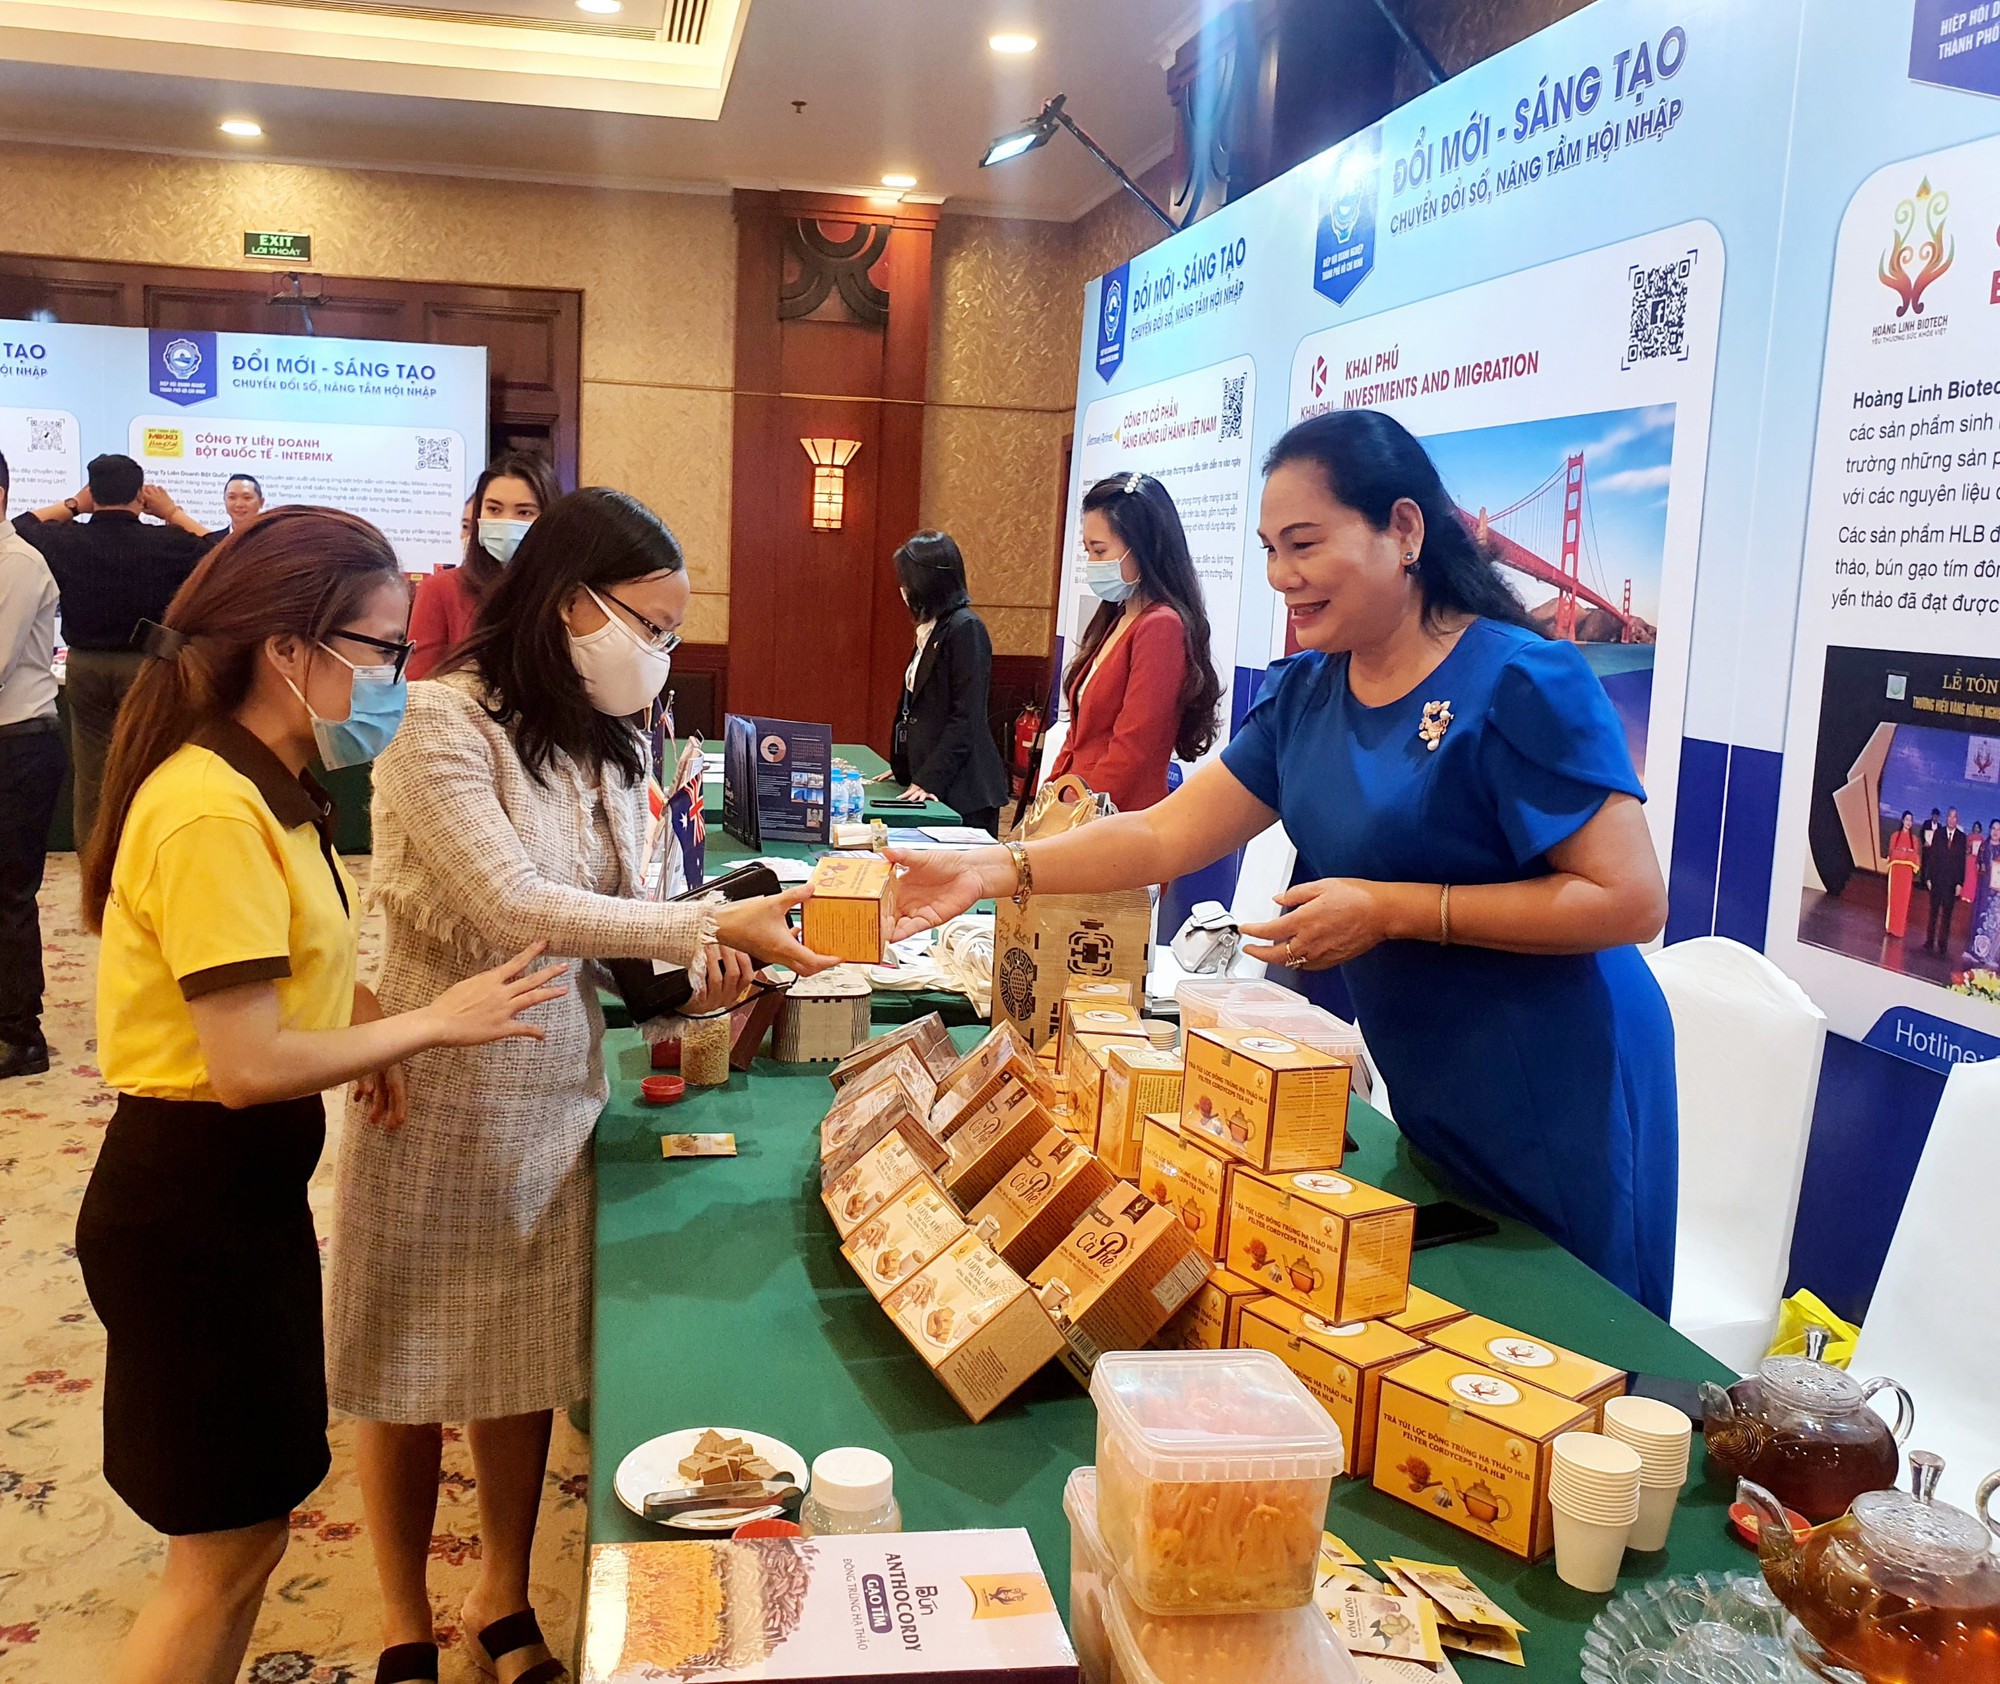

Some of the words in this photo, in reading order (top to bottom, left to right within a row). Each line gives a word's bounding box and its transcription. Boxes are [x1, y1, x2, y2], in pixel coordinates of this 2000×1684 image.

[1940, 13, 1967, 37] HIỆP
[1969, 4, 1990, 27] HỘI
[1938, 34, 1974, 60] THÀNH
[1976, 20, 2000, 48] PHỐ
[1393, 126, 1433, 196] ĐỔI
[1440, 109, 1489, 175] MỚI
[1514, 74, 1601, 142] SÁNG
[1612, 25, 1687, 105] TẠO
[1389, 196, 1438, 236] CHUYỂN
[1441, 177, 1466, 215] ĐỔI
[1469, 169, 1492, 203] SỐ,
[1496, 158, 1542, 194] NÂNG
[1546, 133, 1581, 174] TẦM
[1586, 125, 1620, 162] HỘI
[1625, 99, 1683, 146] NHẬP
[259, 234, 294, 247] EXIT
[1133, 271, 1152, 314] ĐỔI
[1154, 266, 1175, 303] MỚI
[1183, 252, 1217, 290] SÁNG
[1220, 237, 1246, 282] TẠO
[1209, 287, 1223, 314] HỘI
[1223, 280, 1245, 306] NHẬP
[1872, 323, 1897, 337] HOÀNG
[1898, 320, 1915, 333] LINH
[1917, 314, 1949, 330] BIOTECH
[3, 342, 47, 364] TẠO
[232, 348, 269, 372] ĐỔI
[277, 355, 316, 375] MỚI
[334, 357, 390, 378] SÁNG
[396, 364, 436, 385] TẠO
[1344, 354, 1372, 381] KHAI
[1374, 343, 1400, 374] PHÚ
[16, 364, 48, 380] NHẬP
[1343, 379, 1418, 410] INVESTMENTS
[1421, 369, 1450, 394] AND
[1453, 350, 1540, 389] MIGRATION
[384, 384, 404, 399] HỘI
[407, 384, 437, 400] NHẬP
[1853, 390, 1904, 410] Hoàng
[1908, 384, 1943, 404] Linh
[1121, 431, 1138, 450] HÀNG
[1138, 426, 1160, 447] KHÔNG
[1169, 420, 1187, 441] HÀNH
[1200, 415, 1218, 434] NAM
[1123, 411, 1141, 429] CÔNG
[1142, 410, 1150, 424] TY
[1849, 426, 1875, 442] các
[1879, 422, 1905, 440] sản
[1909, 414, 1955, 441] phẩm
[1959, 413, 1994, 434] sinh
[195, 432, 232, 445] CÔNG
[236, 435, 248, 446] TY
[251, 434, 275, 447] LIÊN
[278, 437, 320, 449] DOANH
[195, 446, 218, 459] BỘT
[221, 446, 257, 459] QUỐC
[260, 447, 274, 460] TẾ
[281, 452, 334, 463] INTERMIX
[1846, 455, 1897, 476] trường
[1901, 451, 1952, 472] những
[1957, 448, 1987, 467] sản
[1842, 485, 1865, 506] với
[1869, 486, 1895, 504] các
[1899, 484, 1957, 508] nguyên
[1961, 482, 1991, 506] liệu
[1838, 526, 1867, 544] Các
[1870, 525, 1897, 544] sản
[1900, 523, 1945, 548] phẩm
[1949, 525, 1986, 544] HLB
[1835, 558, 1870, 579] thảo,
[1875, 559, 1903, 577] bún
[1908, 562, 1938, 581] gạo
[1943, 559, 1968, 578] tím
[1831, 587, 1857, 610] yến
[1861, 590, 1893, 609] thảo
[1897, 592, 1917, 610] đã
[1921, 592, 1947, 615] đạt
[1952, 594, 2000, 617] được
[1942, 667, 1963, 691] LỄ
[1965, 673, 1999, 695] TÔN
[1248, 1216, 1266, 1229] FILTER
[1266, 1225, 1298, 1244] CORDYCEPS
[1298, 1239, 1309, 1250] TEA
[1076, 1231, 1098, 1253] Cà
[1088, 1231, 1129, 1268] Phê
[1383, 1413, 1397, 1425] TRÀ
[1398, 1417, 1411, 1431] TÚI
[1412, 1426, 1427, 1438] LỌC
[1428, 1432, 1450, 1448] ĐÔNG
[1451, 1441, 1477, 1460] TRÙNG
[1479, 1453, 1490, 1465] HẠ
[1491, 1458, 1513, 1475] THẢO
[1514, 1469, 1531, 1482] HLB
[1402, 1431, 1428, 1448] FILTER
[1428, 1442, 1473, 1467] CORDYCEPS
[1474, 1462, 1489, 1475] TEA
[1490, 1468, 1506, 1481] HLB
[843, 1558, 856, 1583] ĐÔNG
[847, 1583, 862, 1613] TRÙNG
[864, 1579, 883, 1605] GẠO
[885, 1553, 923, 1652] ANTHOCORDY
[915, 1585, 939, 1616] Bún
[851, 1613, 864, 1627] HẠ
[871, 1607, 889, 1628] TÍM
[854, 1627, 870, 1651] THẢO
